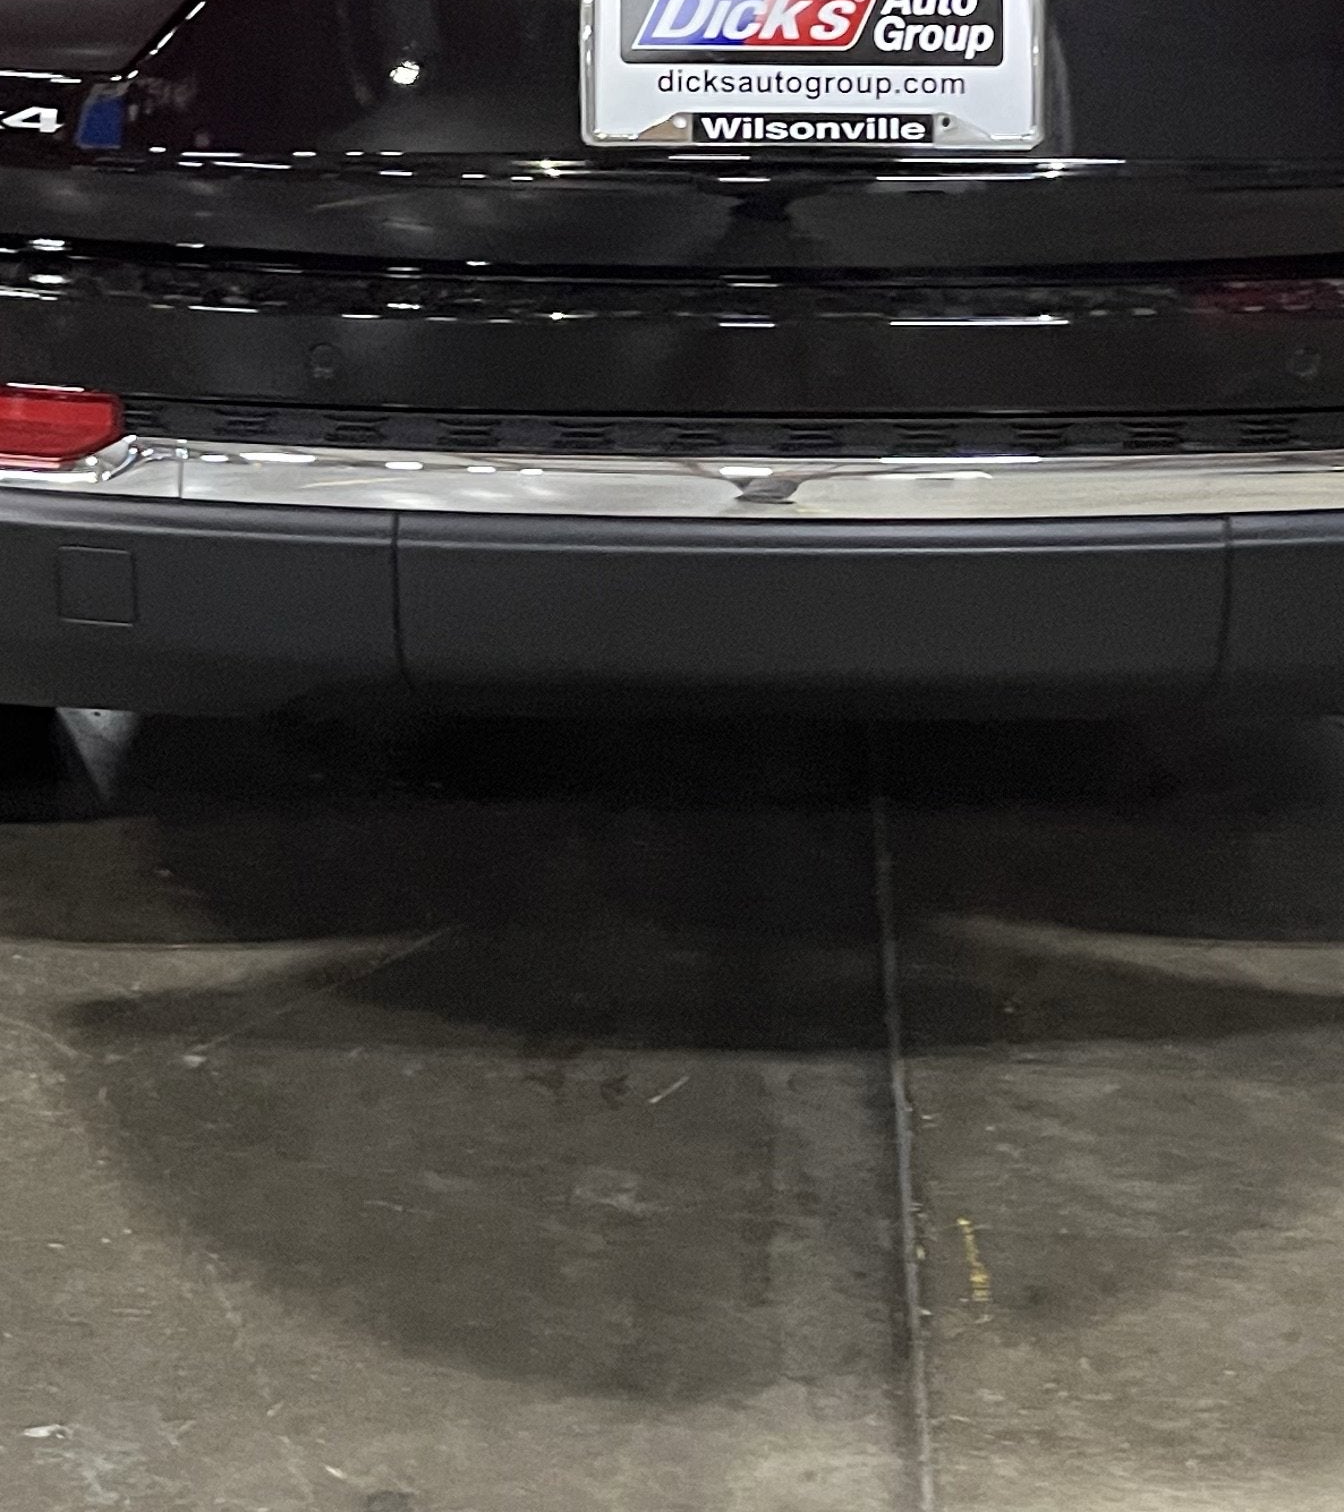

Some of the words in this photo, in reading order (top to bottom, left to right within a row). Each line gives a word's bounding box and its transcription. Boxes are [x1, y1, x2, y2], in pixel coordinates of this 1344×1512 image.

[873, 15, 995, 59] Group
[657, 69, 966, 100] dicksautogroup.com
[701, 116, 926, 140] Wilsonville
